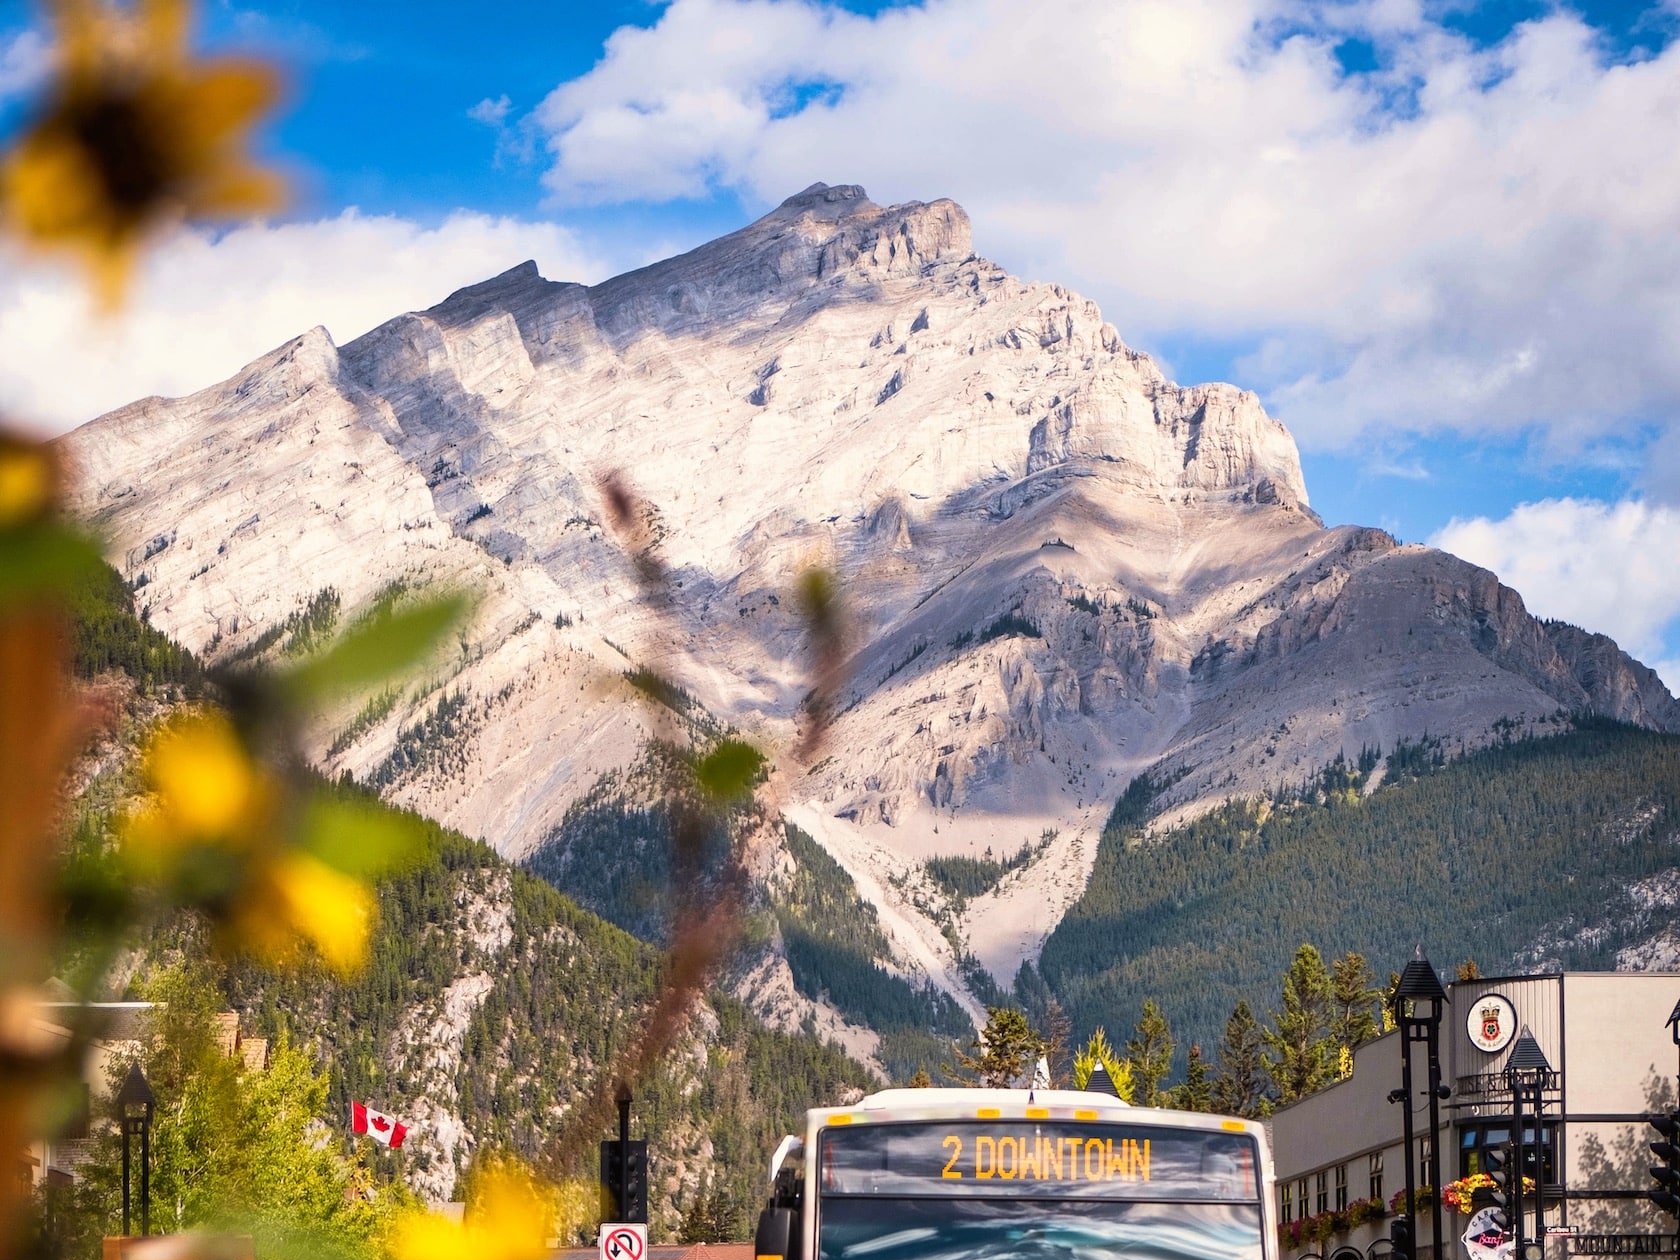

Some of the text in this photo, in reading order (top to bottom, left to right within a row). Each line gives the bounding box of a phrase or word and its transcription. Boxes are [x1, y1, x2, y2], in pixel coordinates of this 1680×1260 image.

[941, 1135, 1150, 1182] 2 DOWNTOWN
[1575, 1237, 1660, 1253] MOUNTAIN
